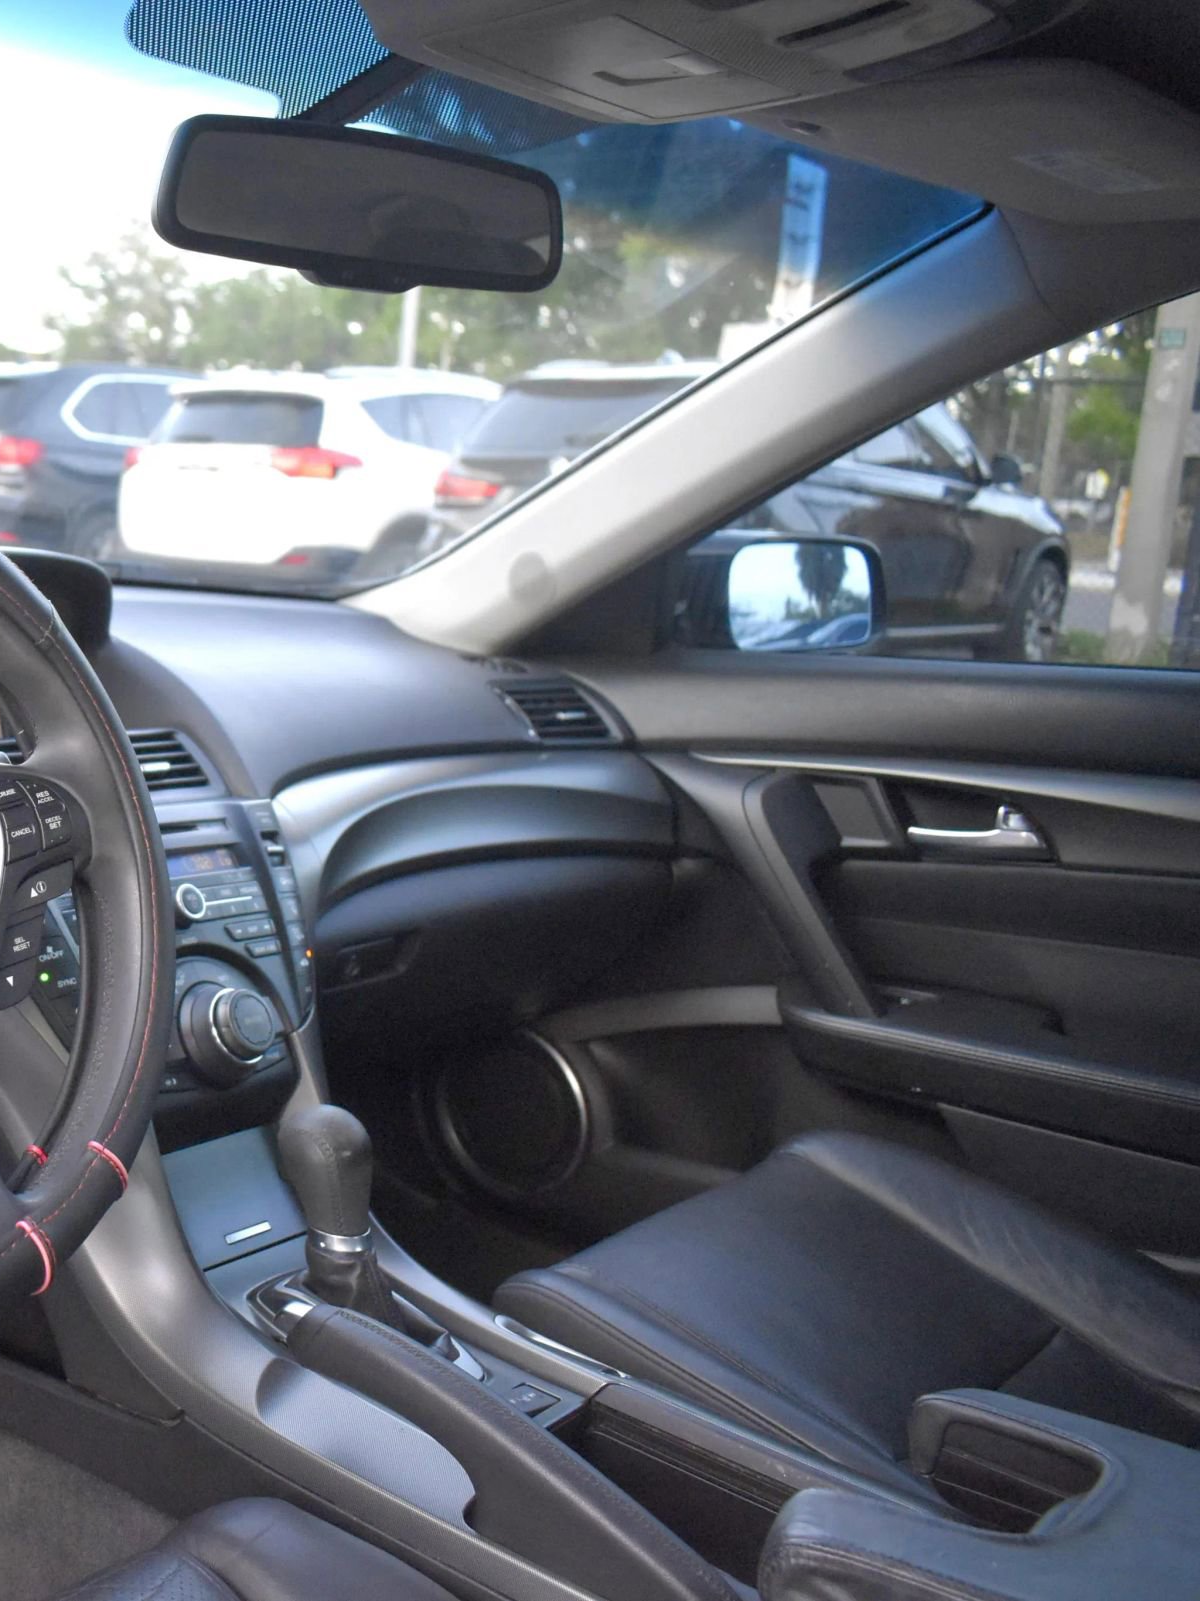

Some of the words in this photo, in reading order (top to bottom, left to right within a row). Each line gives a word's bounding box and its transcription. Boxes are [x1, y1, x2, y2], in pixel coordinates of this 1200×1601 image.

[35, 790, 50, 799] RES
[37, 796, 55, 804] ACCEL
[44, 815, 63, 824] DECEL
[48, 820, 62, 830] SET
[10, 827, 33, 838] CANCEL
[13, 936, 26, 945] SEL
[12, 941, 31, 953] RESET
[57, 977, 78, 989] SYNC
